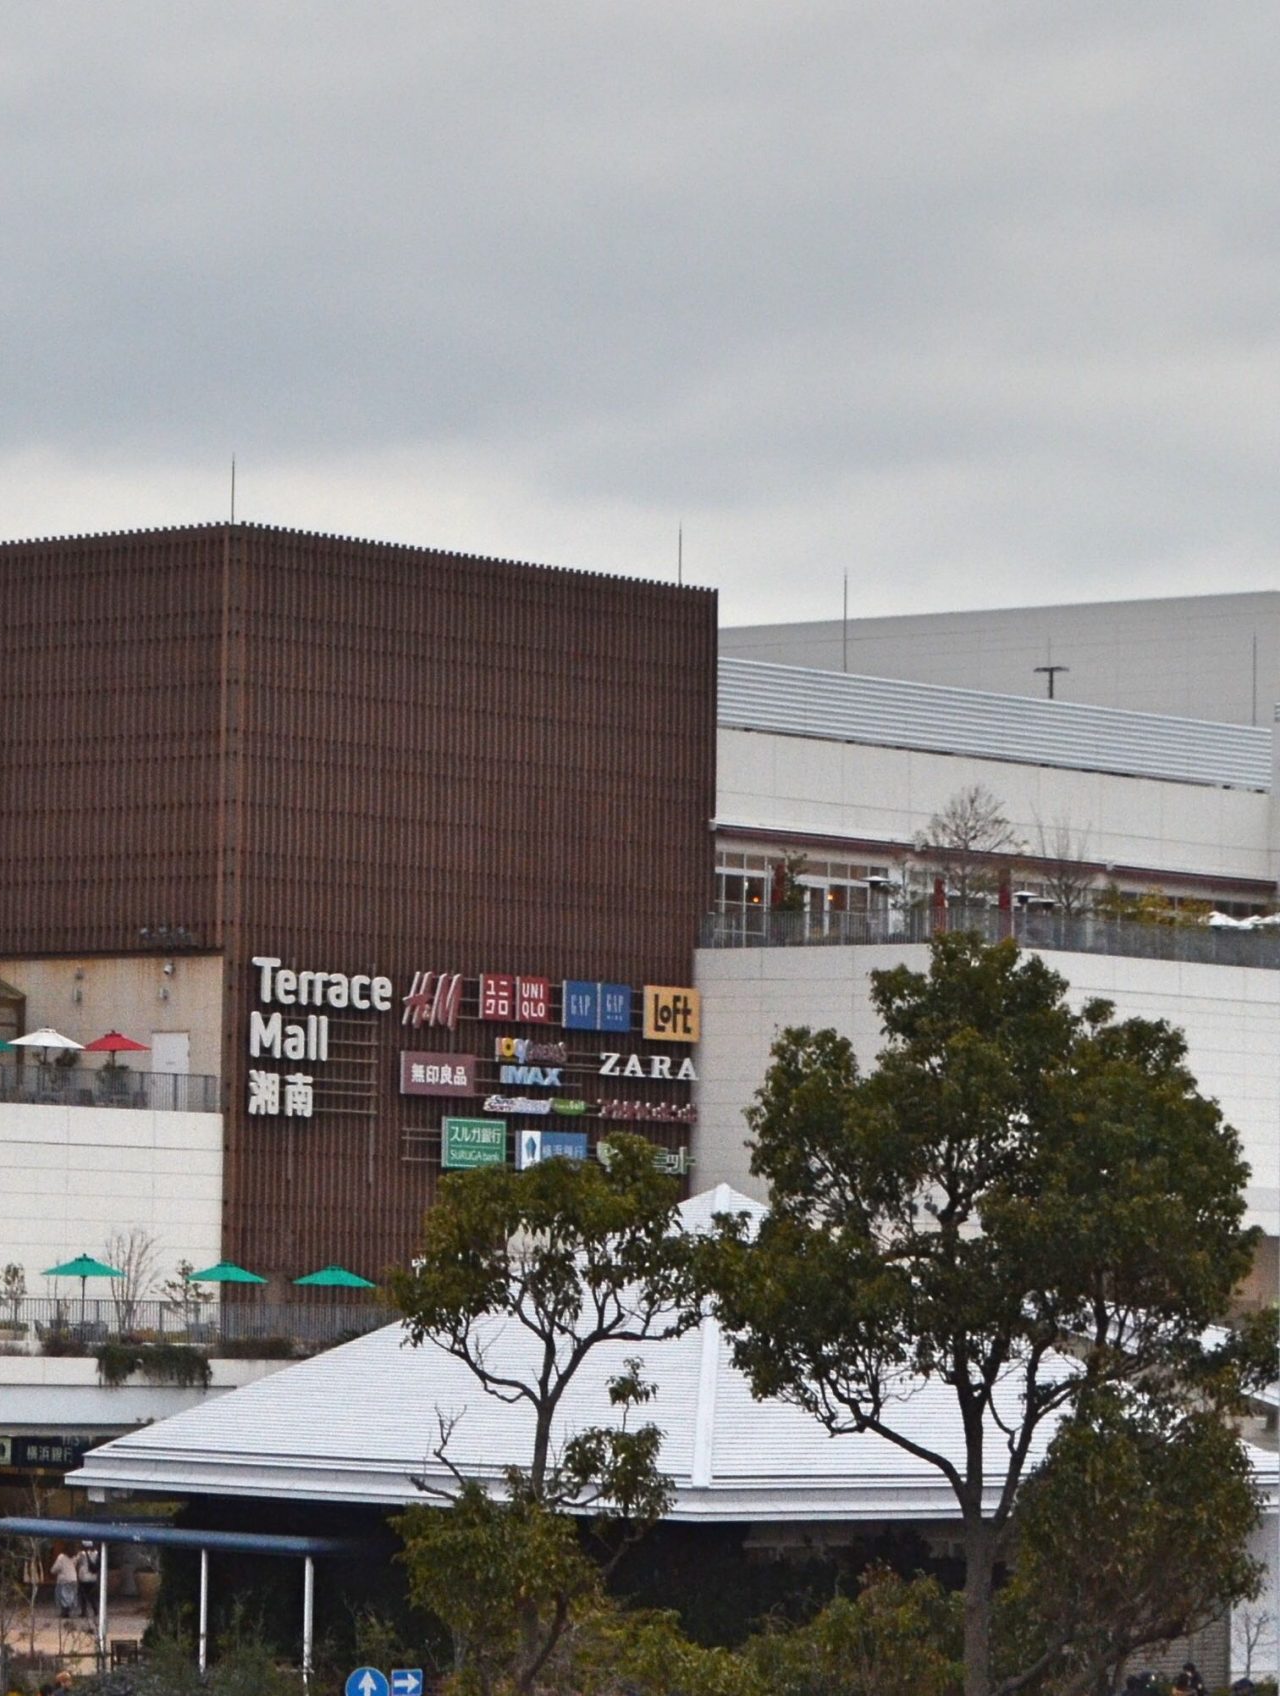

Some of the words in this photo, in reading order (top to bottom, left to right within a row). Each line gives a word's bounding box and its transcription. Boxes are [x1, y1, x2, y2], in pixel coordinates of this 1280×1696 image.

[251, 956, 393, 1012] Terrace
[486, 979, 509, 997] ユニ
[521, 982, 545, 999] UNI
[402, 971, 463, 1032] H&M
[485, 999, 509, 1016] クロ
[521, 1000, 546, 1020] QLO
[570, 993, 591, 1017] GAP
[606, 993, 624, 1014] GAP
[250, 1010, 329, 1062] Mall
[411, 1063, 468, 1087] 無印良品
[500, 1065, 563, 1087] IMAX
[599, 1052, 700, 1081] ZARA
[248, 1069, 314, 1118] 湘南
[450, 1126, 502, 1145] スルガ銀行
